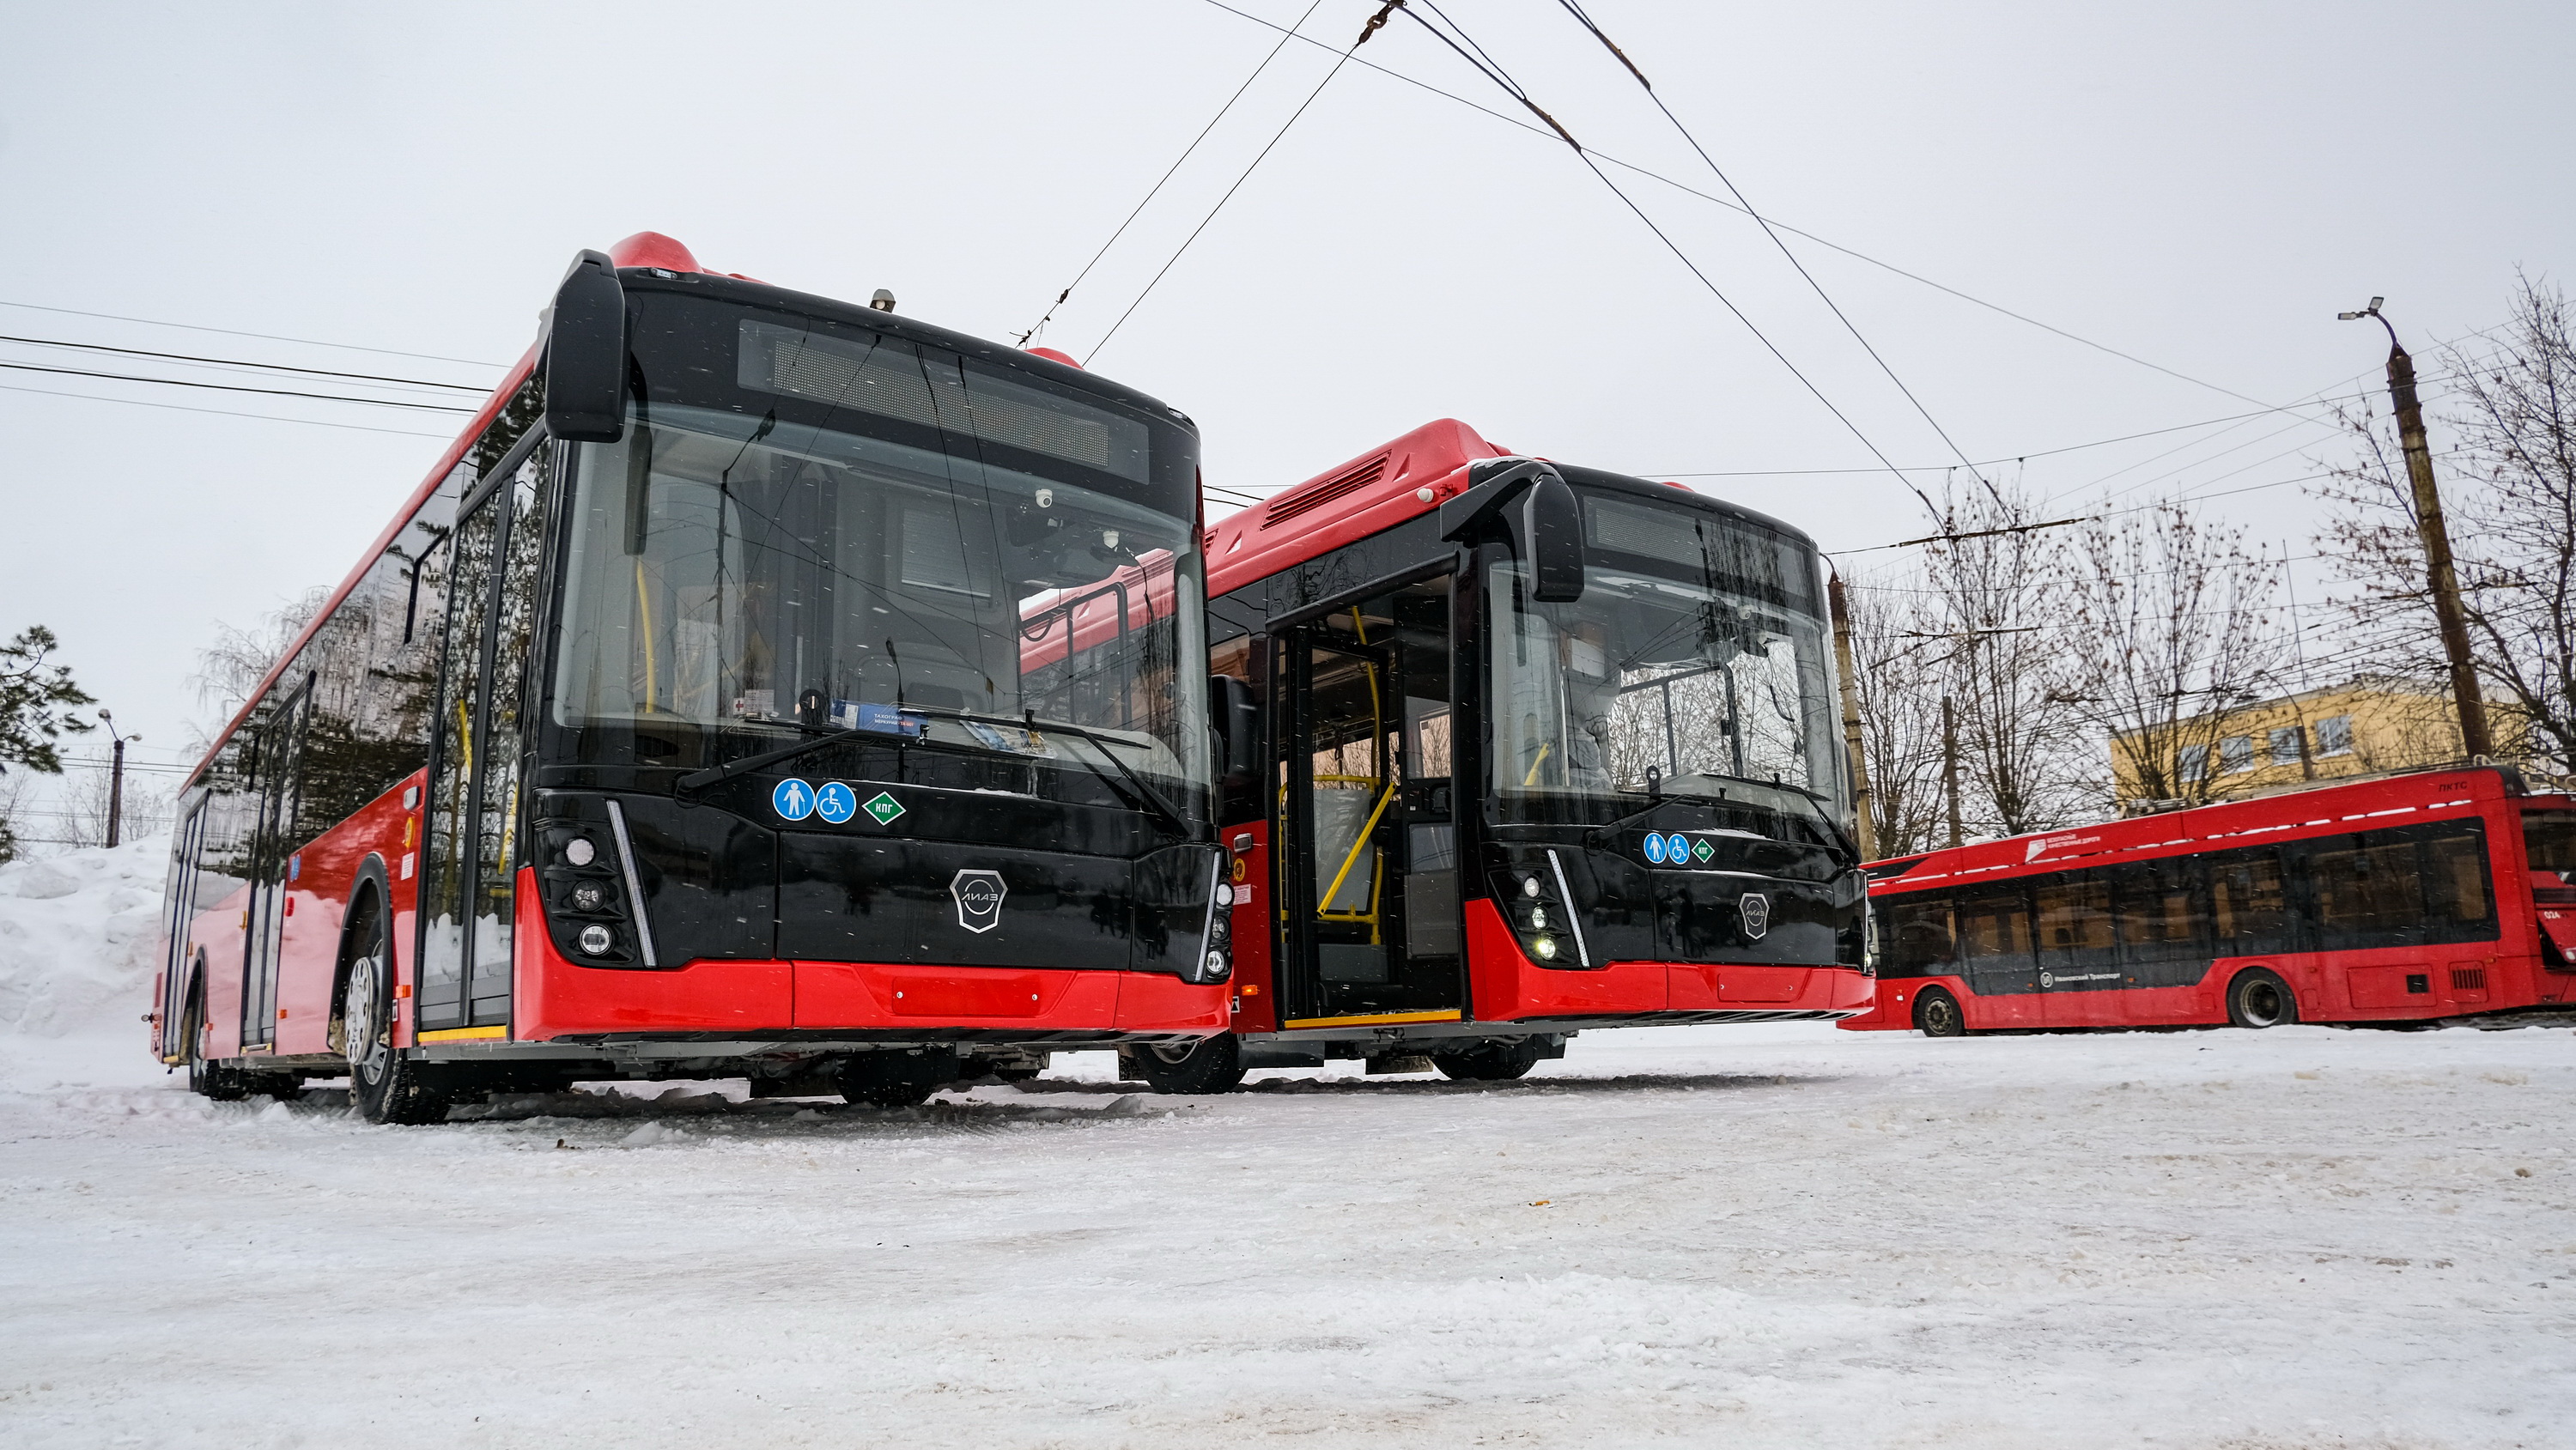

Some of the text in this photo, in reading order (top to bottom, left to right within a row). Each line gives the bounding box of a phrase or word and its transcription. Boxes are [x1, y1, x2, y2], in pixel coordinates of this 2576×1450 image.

[2439, 781, 2468, 792] ПКТС
[876, 803, 893, 814] КПГ
[961, 893, 999, 901] ЛИАЗ
[2543, 911, 2561, 919] 024
